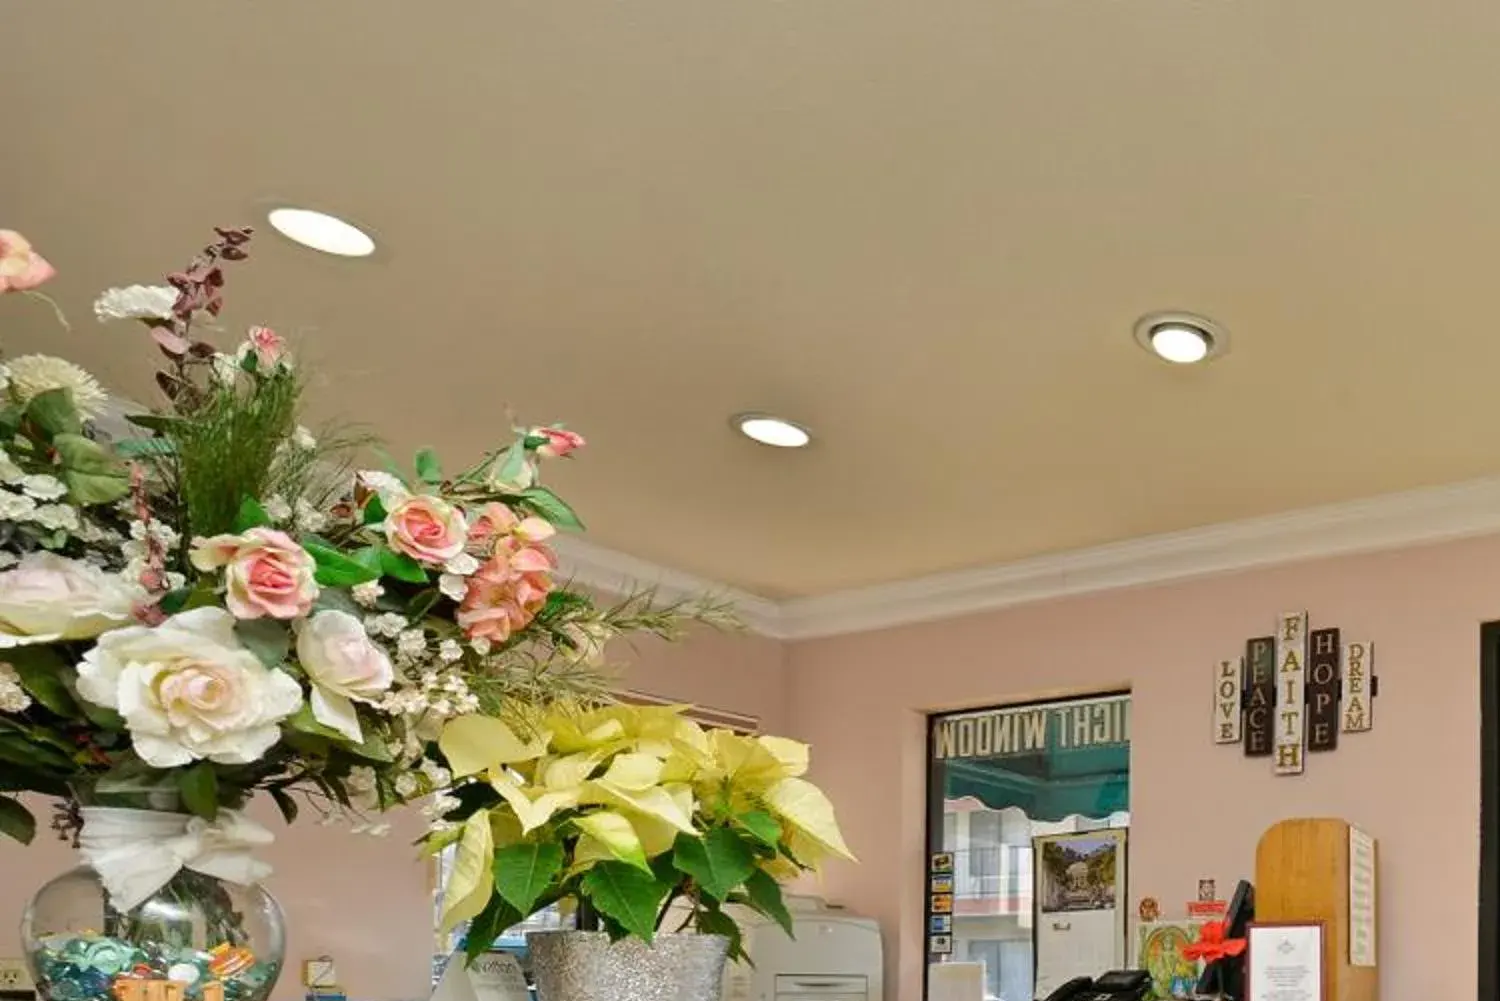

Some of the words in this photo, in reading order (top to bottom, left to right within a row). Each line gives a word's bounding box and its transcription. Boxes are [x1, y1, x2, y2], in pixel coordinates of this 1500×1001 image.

[1219, 660, 1236, 740] LOVE
[1251, 641, 1267, 751] PEACE
[1277, 616, 1302, 768] FAITH
[1313, 633, 1334, 745] HOPE
[1344, 643, 1365, 730] DREAM
